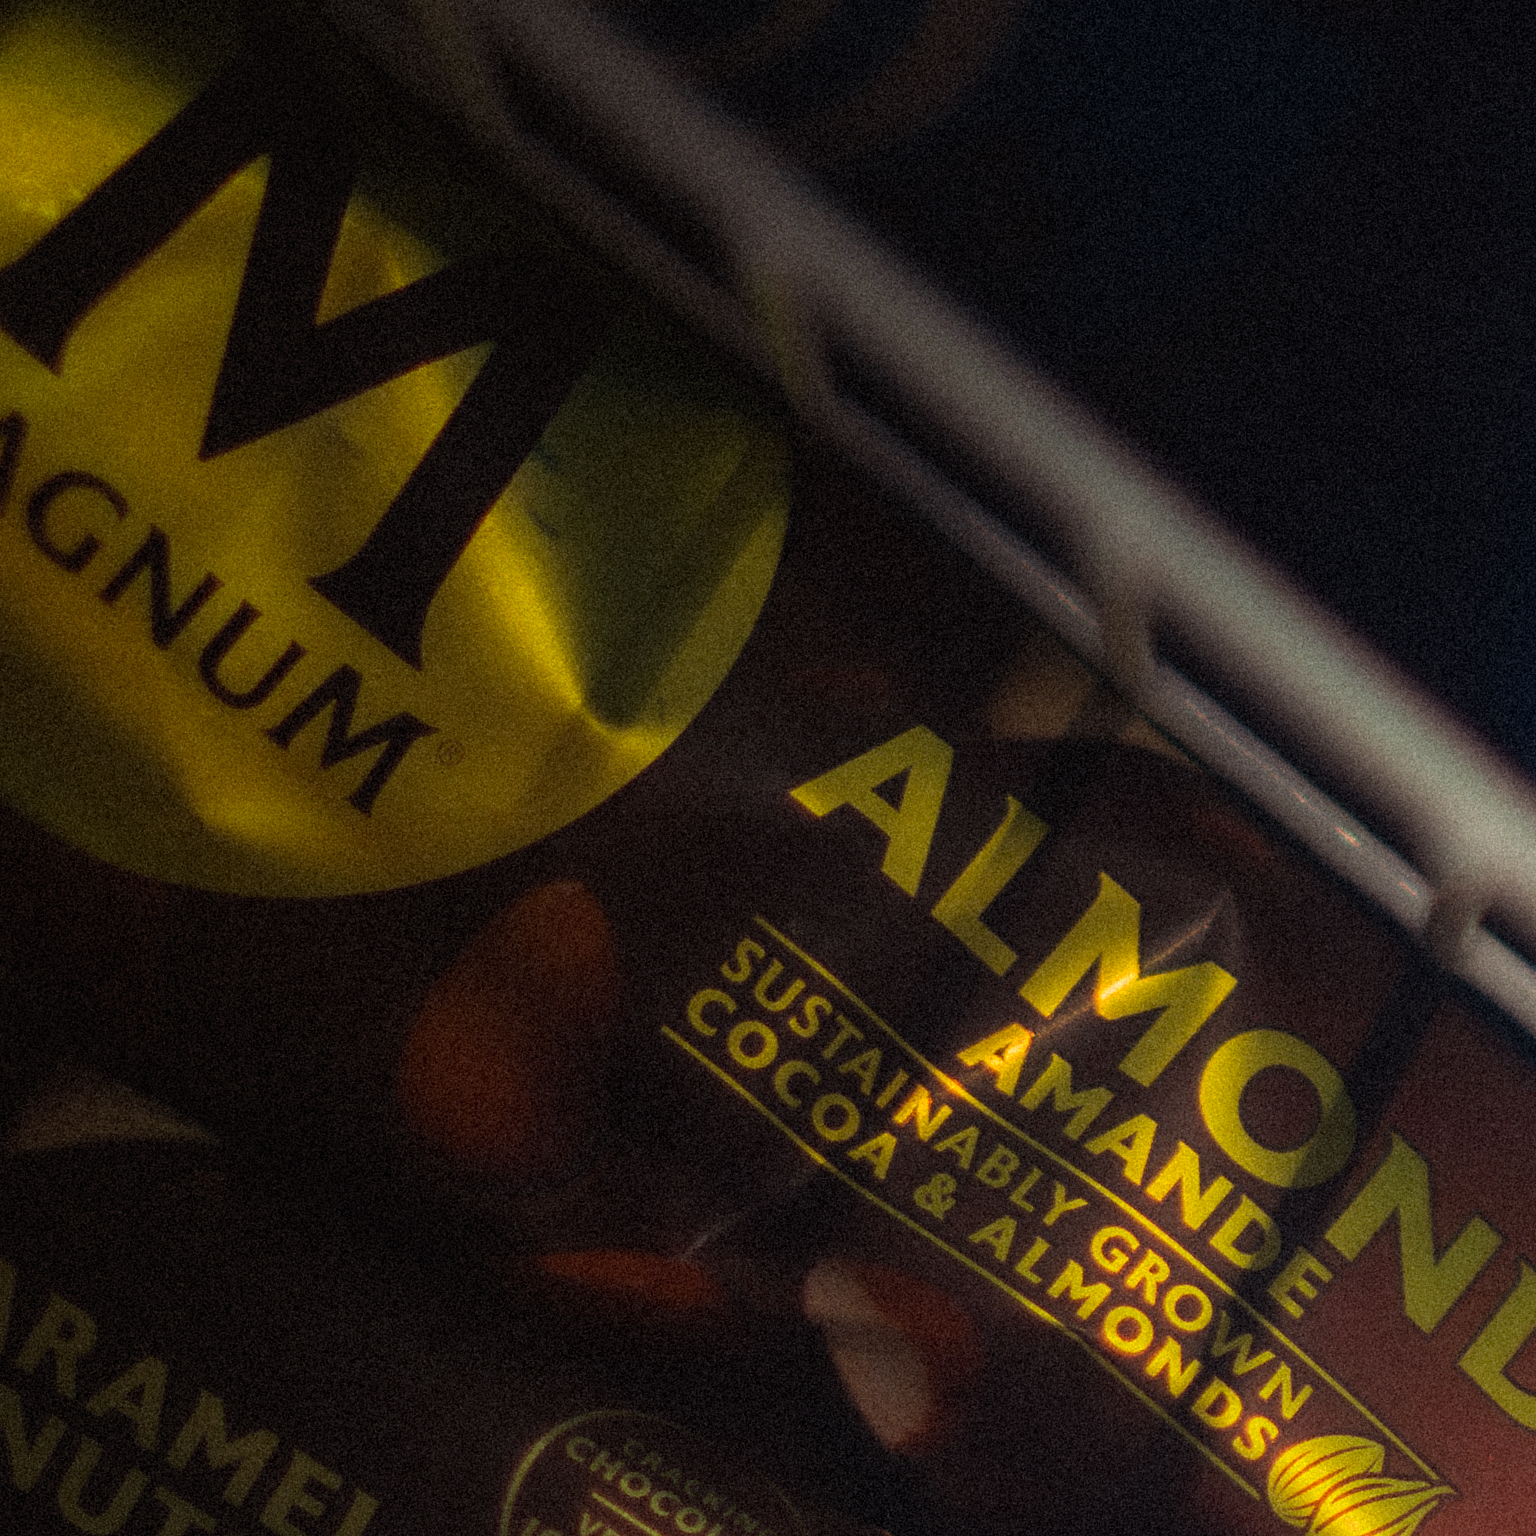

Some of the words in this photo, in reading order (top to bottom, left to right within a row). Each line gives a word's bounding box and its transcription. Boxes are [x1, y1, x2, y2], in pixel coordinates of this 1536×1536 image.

[685, 986, 898, 1184] COCOA
[914, 1172, 957, 1220] &
[968, 1218, 1281, 1463] ALMONDS
[720, 936, 1088, 1227] SUSTAINABLY
[1090, 1223, 1314, 1420] GROWN
[957, 1021, 1333, 1320] AMANDE
